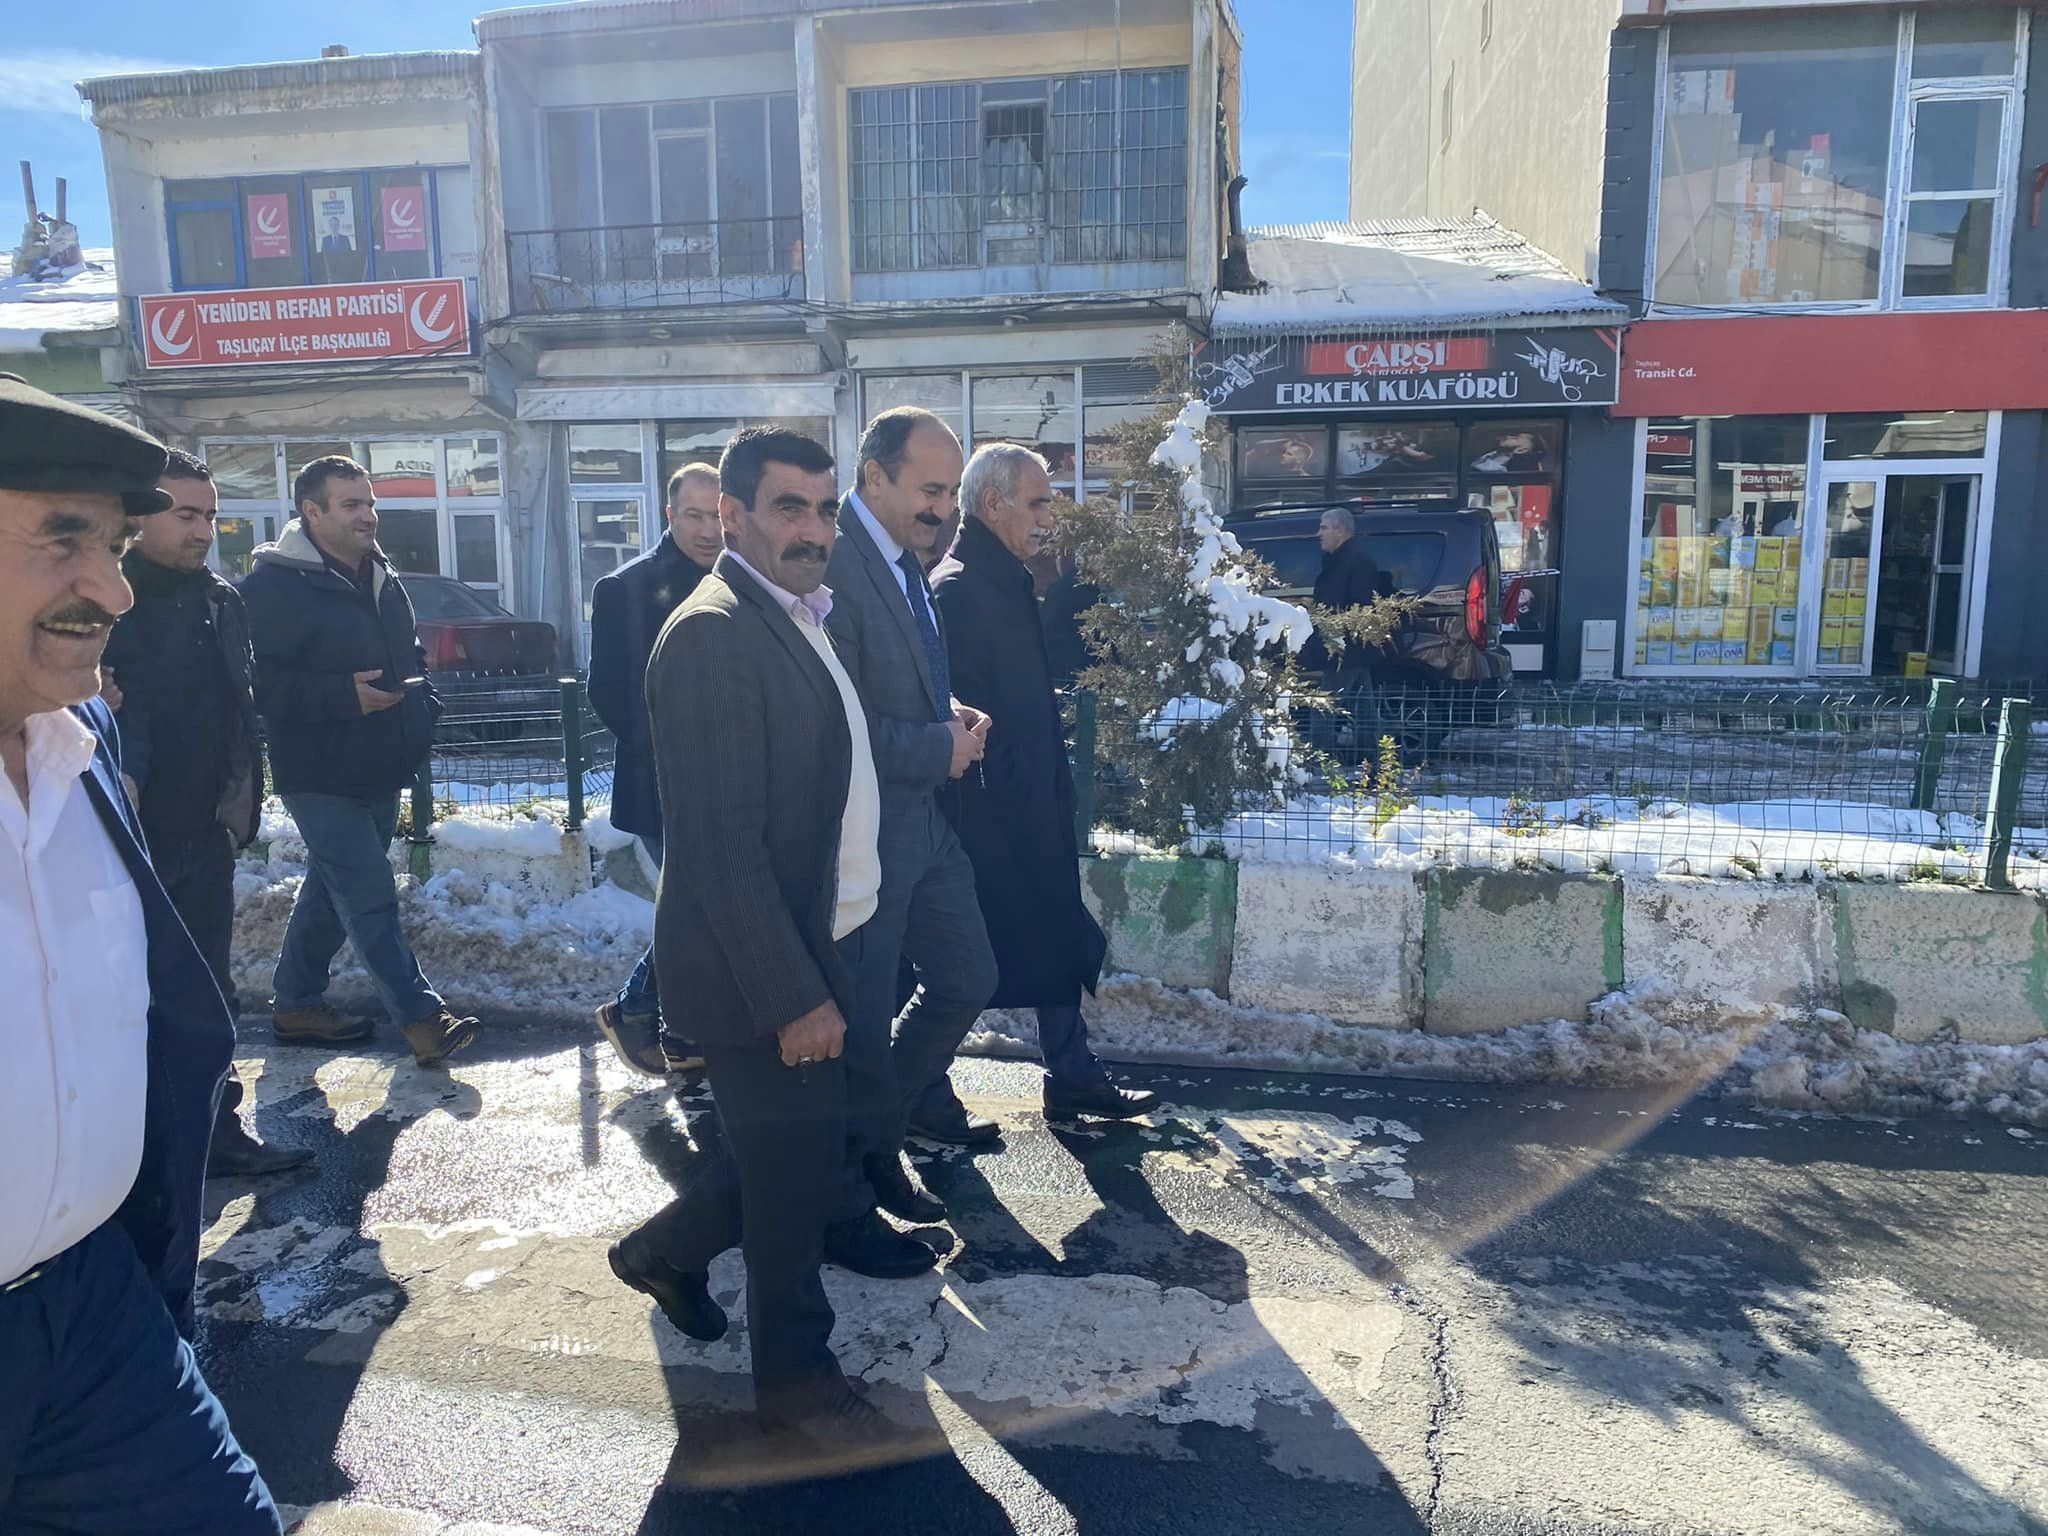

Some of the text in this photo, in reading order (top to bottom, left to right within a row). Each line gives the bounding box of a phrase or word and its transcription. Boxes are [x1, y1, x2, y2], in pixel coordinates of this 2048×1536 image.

[198, 287, 404, 324] YENİDEN REFAH PARTİSİ
[216, 328, 391, 358] TAŞLIÇAY İLÇE BAŞKANLIĞI
[1344, 341, 1446, 376] ÇARŞI
[1276, 371, 1518, 404] ERKEK KUAFÖRÜ
[1635, 367, 1697, 378] Transit Cd.
